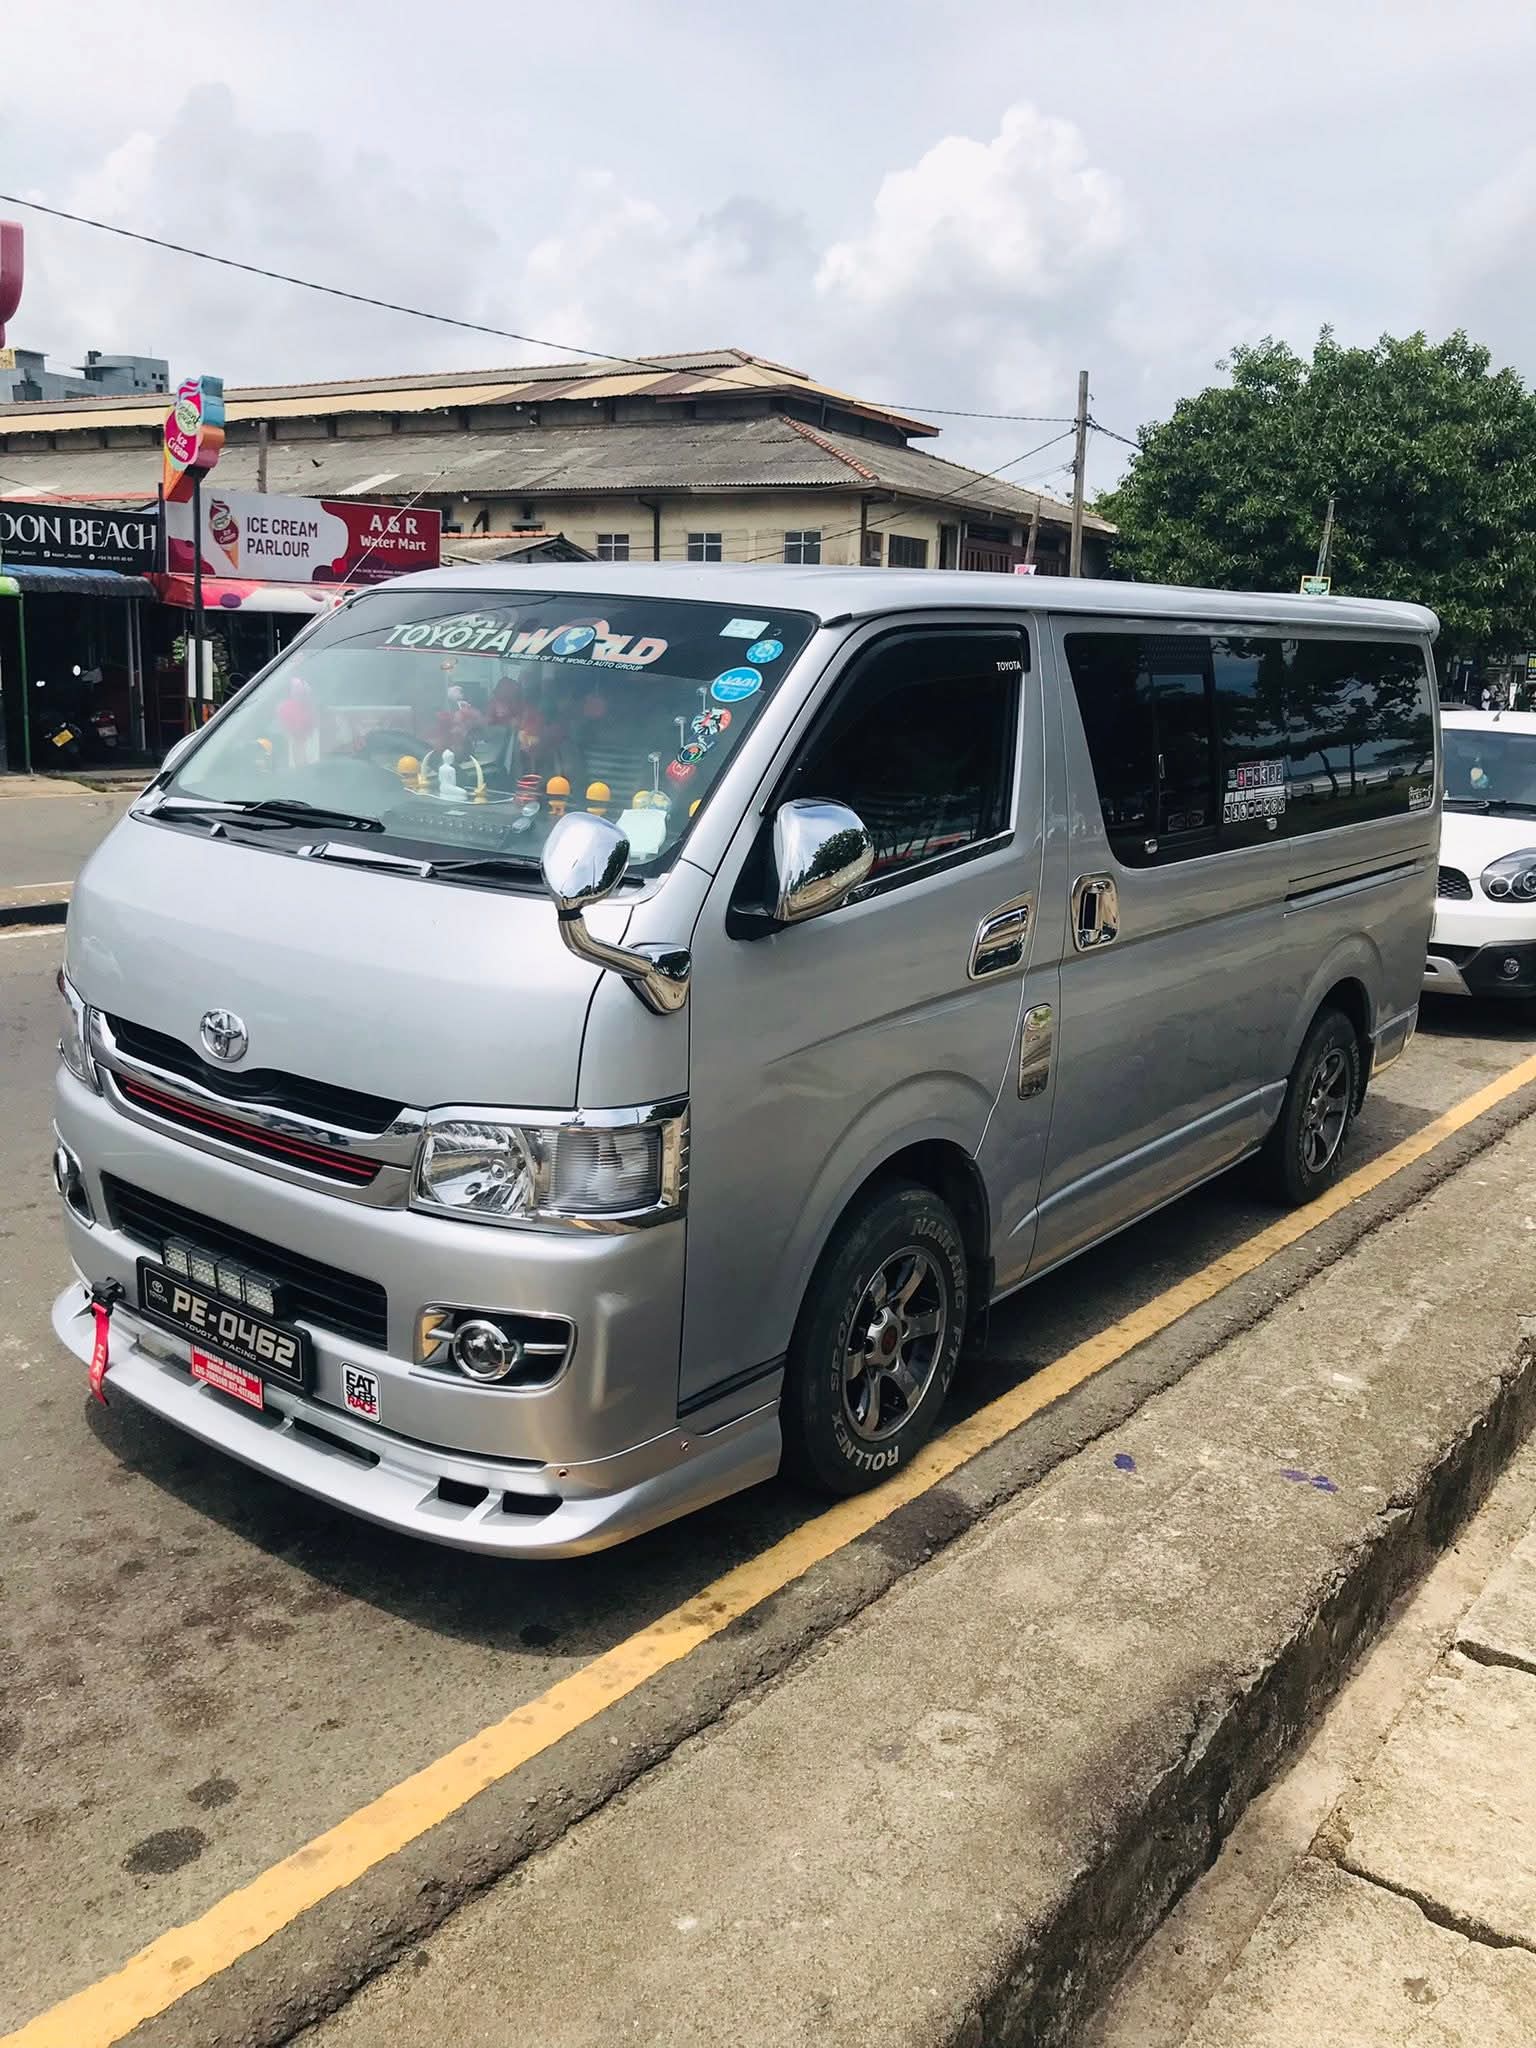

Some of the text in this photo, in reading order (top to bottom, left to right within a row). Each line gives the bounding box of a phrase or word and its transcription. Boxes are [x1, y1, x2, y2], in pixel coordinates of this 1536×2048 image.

[69, 518, 156, 550] BEACH
[247, 516, 268, 534] ICE
[272, 519, 318, 538] CREAM
[370, 514, 418, 534] A & R
[247, 538, 309, 558] PARLOUR
[360, 535, 427, 551] Water Mart
[385, 624, 513, 652] TOYOTA
[566, 657, 593, 666] WORLD
[593, 660, 614, 669] AUTO
[615, 663, 645, 671] GROUP
[996, 660, 1022, 671] TOYOTA
[172, 1287, 296, 1368] PE-0462
[183, 1321, 219, 1343] TOYOTA
[222, 1340, 257, 1361] RACING
[346, 1370, 375, 1394] EAT
[347, 1394, 377, 1415] RACE
[832, 1411, 899, 1471] ROLLNEX
